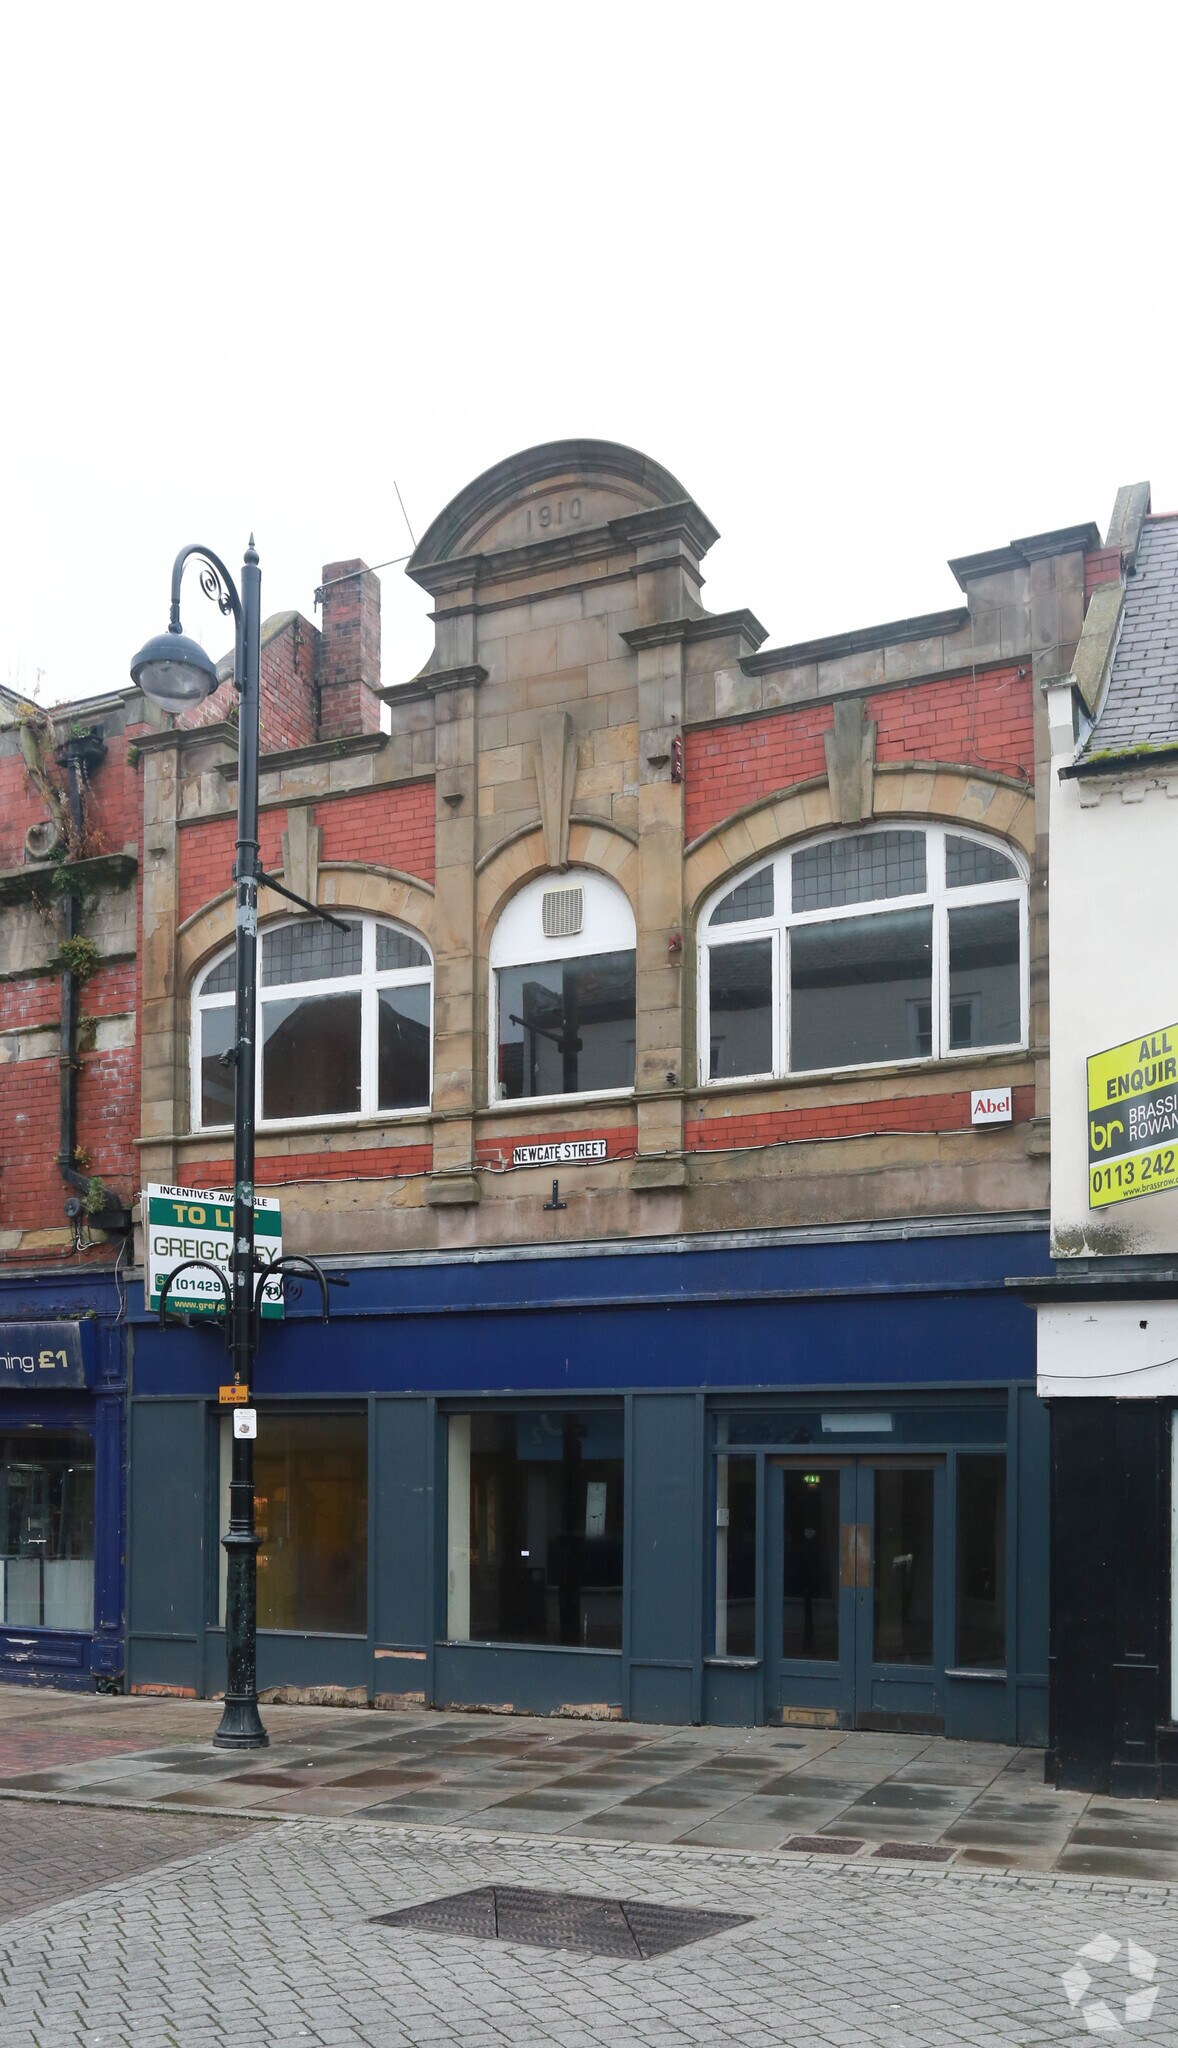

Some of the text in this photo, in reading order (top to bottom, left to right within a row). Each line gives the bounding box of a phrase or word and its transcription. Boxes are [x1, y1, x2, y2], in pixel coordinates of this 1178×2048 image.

[527, 498, 582, 533] 1910
[1138, 1032, 1172, 1063] ALL
[973, 1096, 1010, 1115] Abel
[514, 1141, 605, 1162] NEWGATE STREET
[1092, 1150, 1175, 1194] 0113 242
[160, 1186, 268, 1207] INCENTIVES AVABLE
[172, 1204, 206, 1225] TO
[37, 1350, 68, 1369] £1
